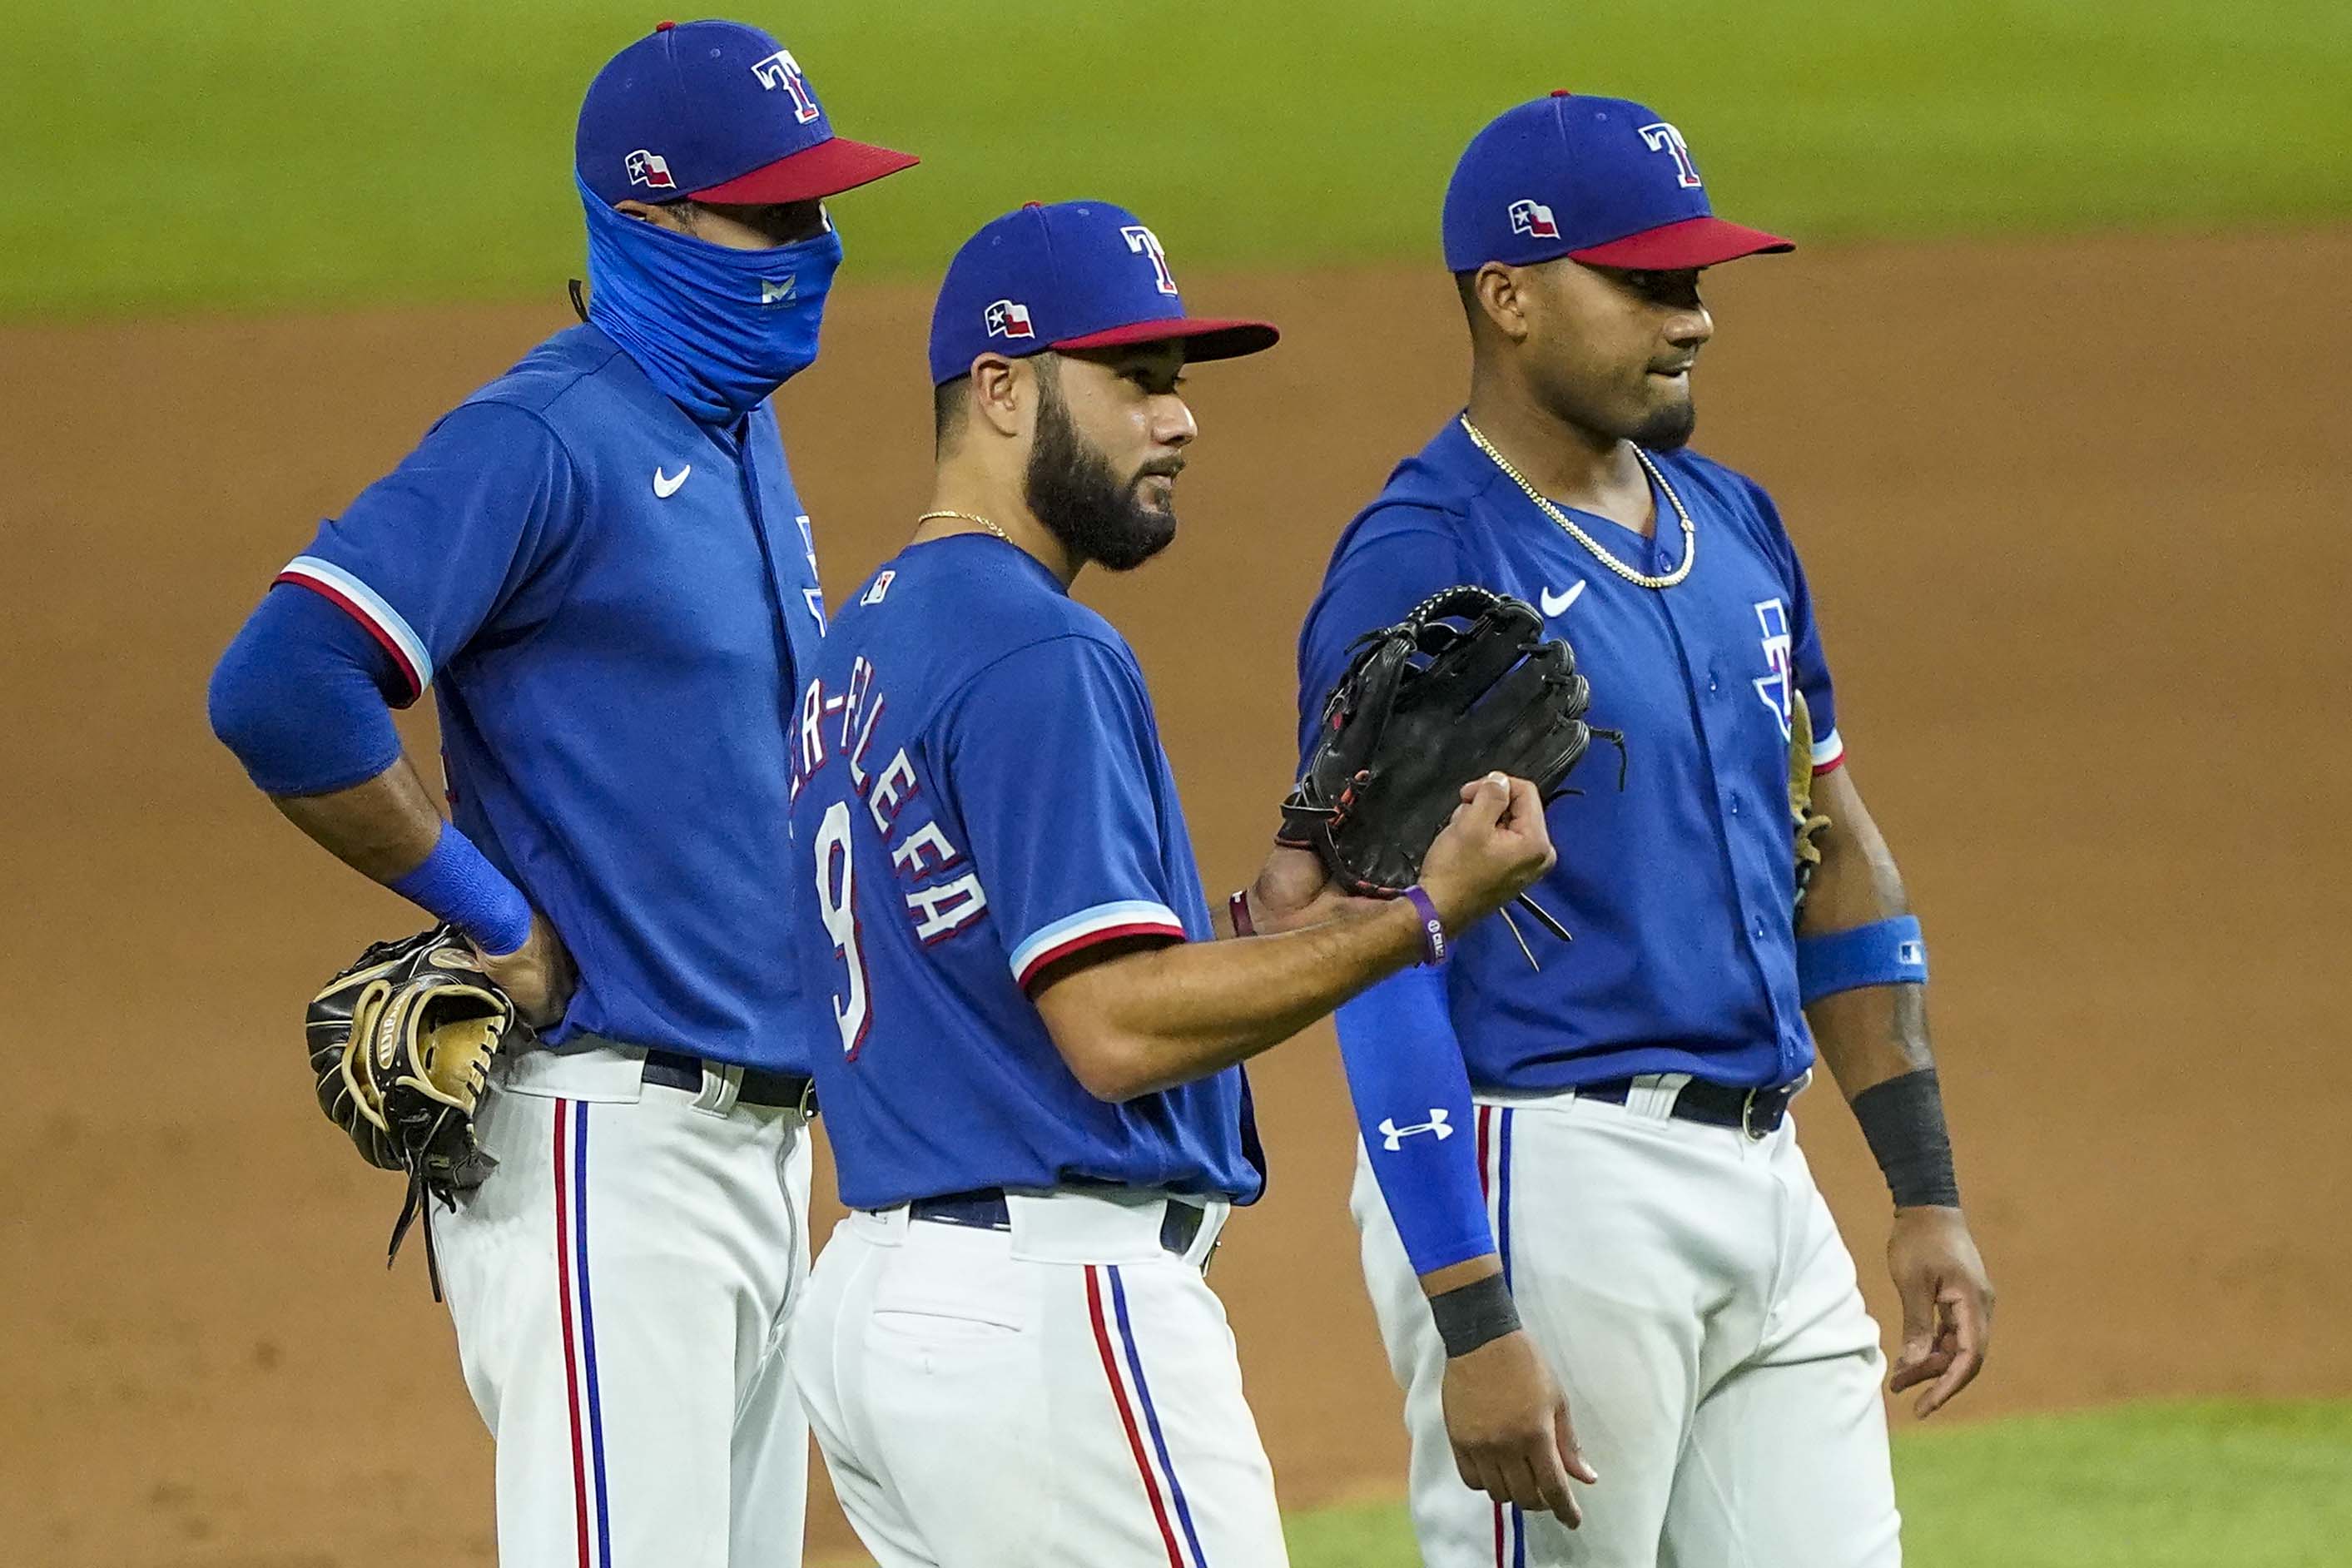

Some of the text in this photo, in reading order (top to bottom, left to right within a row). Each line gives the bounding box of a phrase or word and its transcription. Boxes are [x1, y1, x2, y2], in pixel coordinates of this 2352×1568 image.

[751, 49, 820, 124] T
[1638, 122, 1702, 188] T
[1119, 226, 1178, 297] T
[814, 801, 872, 1063] 9
